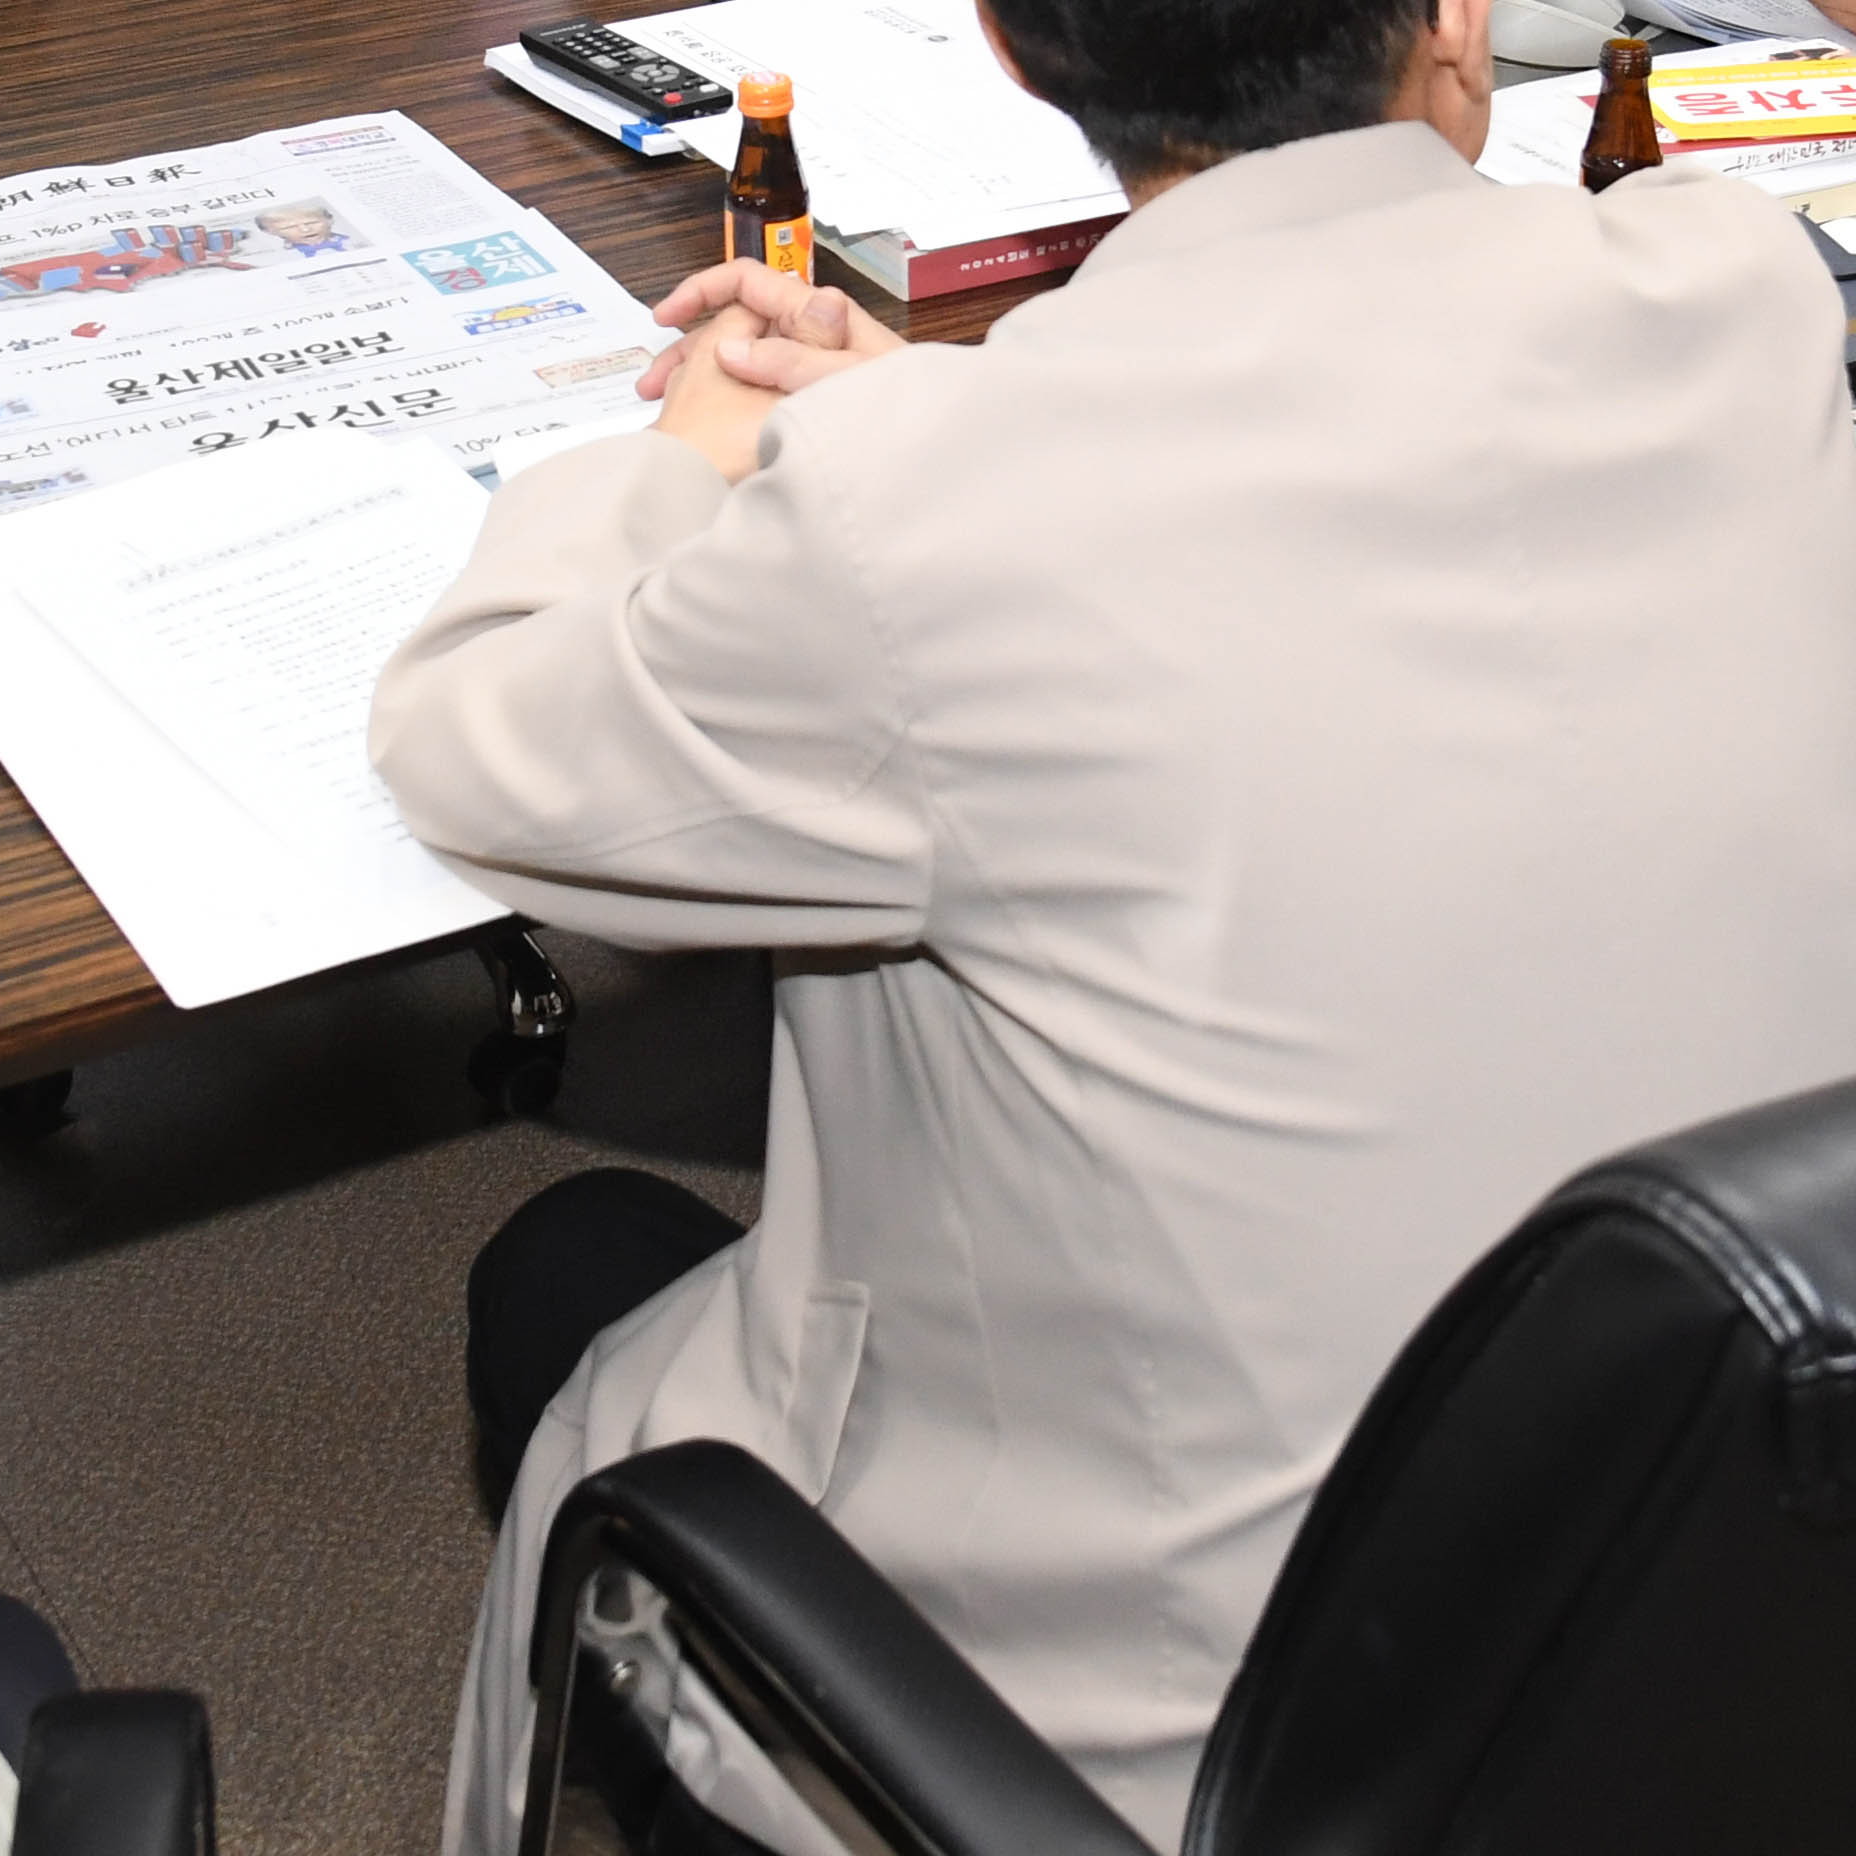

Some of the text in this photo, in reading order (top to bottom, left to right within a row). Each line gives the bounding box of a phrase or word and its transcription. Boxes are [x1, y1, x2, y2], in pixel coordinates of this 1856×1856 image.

[88, 207, 141, 227] 차로
[145, 202, 191, 223] 승부
[200, 187, 277, 214] 갈린다
[104, 330, 406, 406] 울산제일일보
